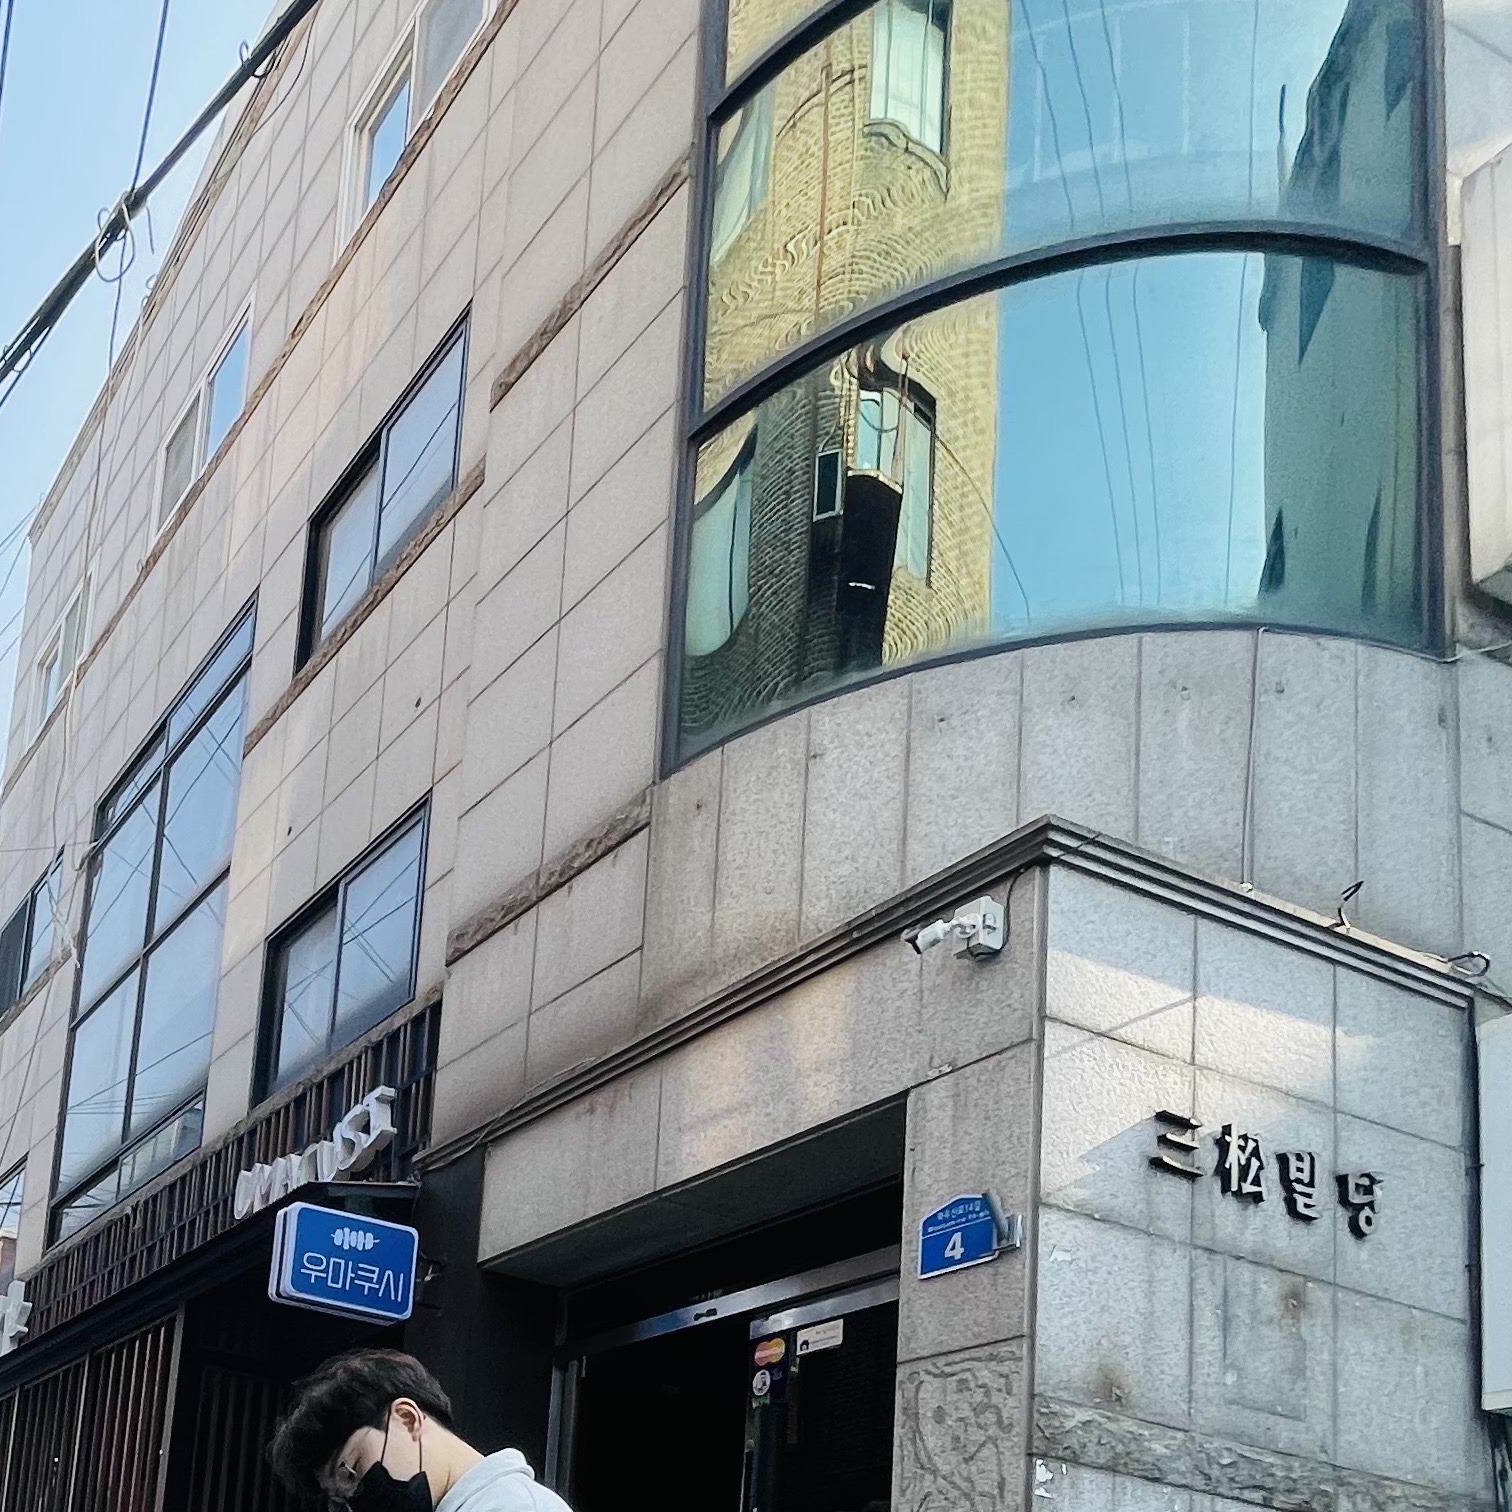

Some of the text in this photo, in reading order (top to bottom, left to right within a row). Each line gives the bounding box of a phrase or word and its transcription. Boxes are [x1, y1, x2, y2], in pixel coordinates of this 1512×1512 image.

[1148, 1110, 1384, 1239] 三松빌딩
[944, 1231, 965, 1261] 4
[300, 1251, 405, 1303] 우마쿠시
